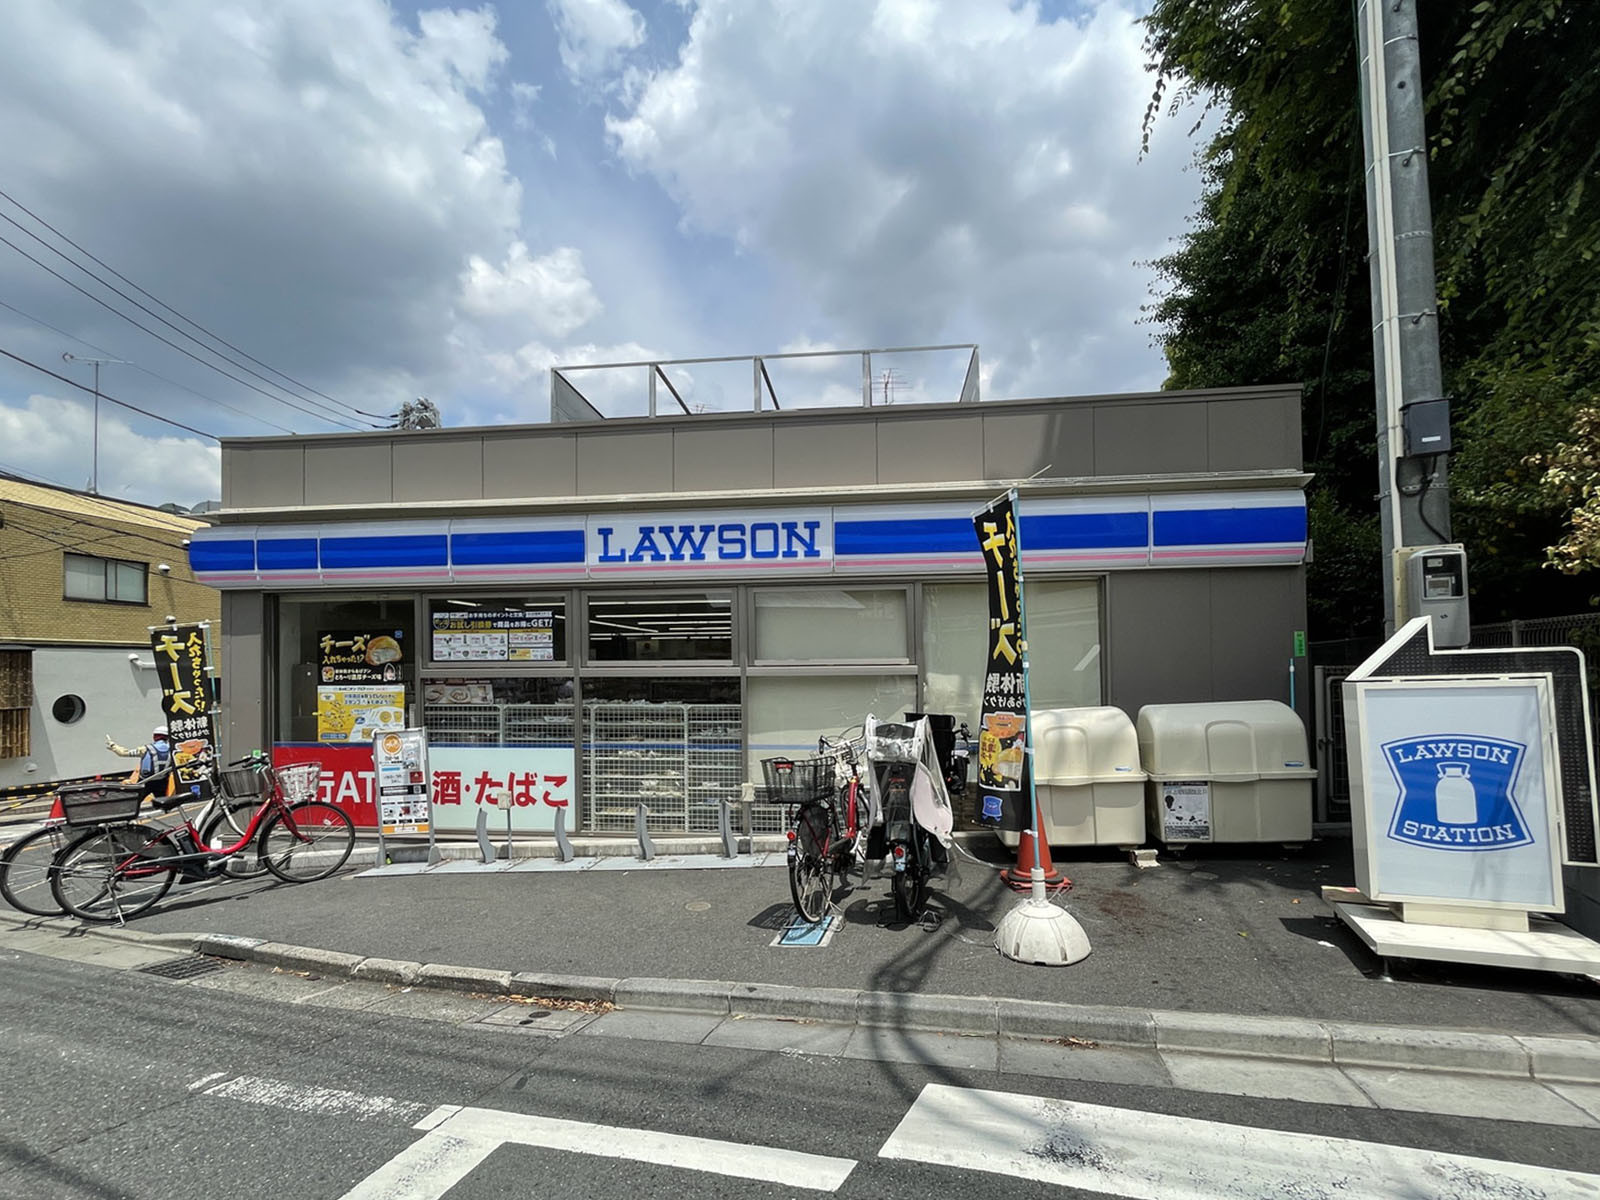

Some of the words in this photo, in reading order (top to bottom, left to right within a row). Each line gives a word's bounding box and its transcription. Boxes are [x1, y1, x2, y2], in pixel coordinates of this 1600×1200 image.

[598, 521, 820, 563] LAWSON
[320, 634, 371, 654] チーズ
[1395, 743, 1512, 764] LAWSON
[431, 770, 569, 808] 酒・たばこ
[1402, 820, 1516, 843] STATION
